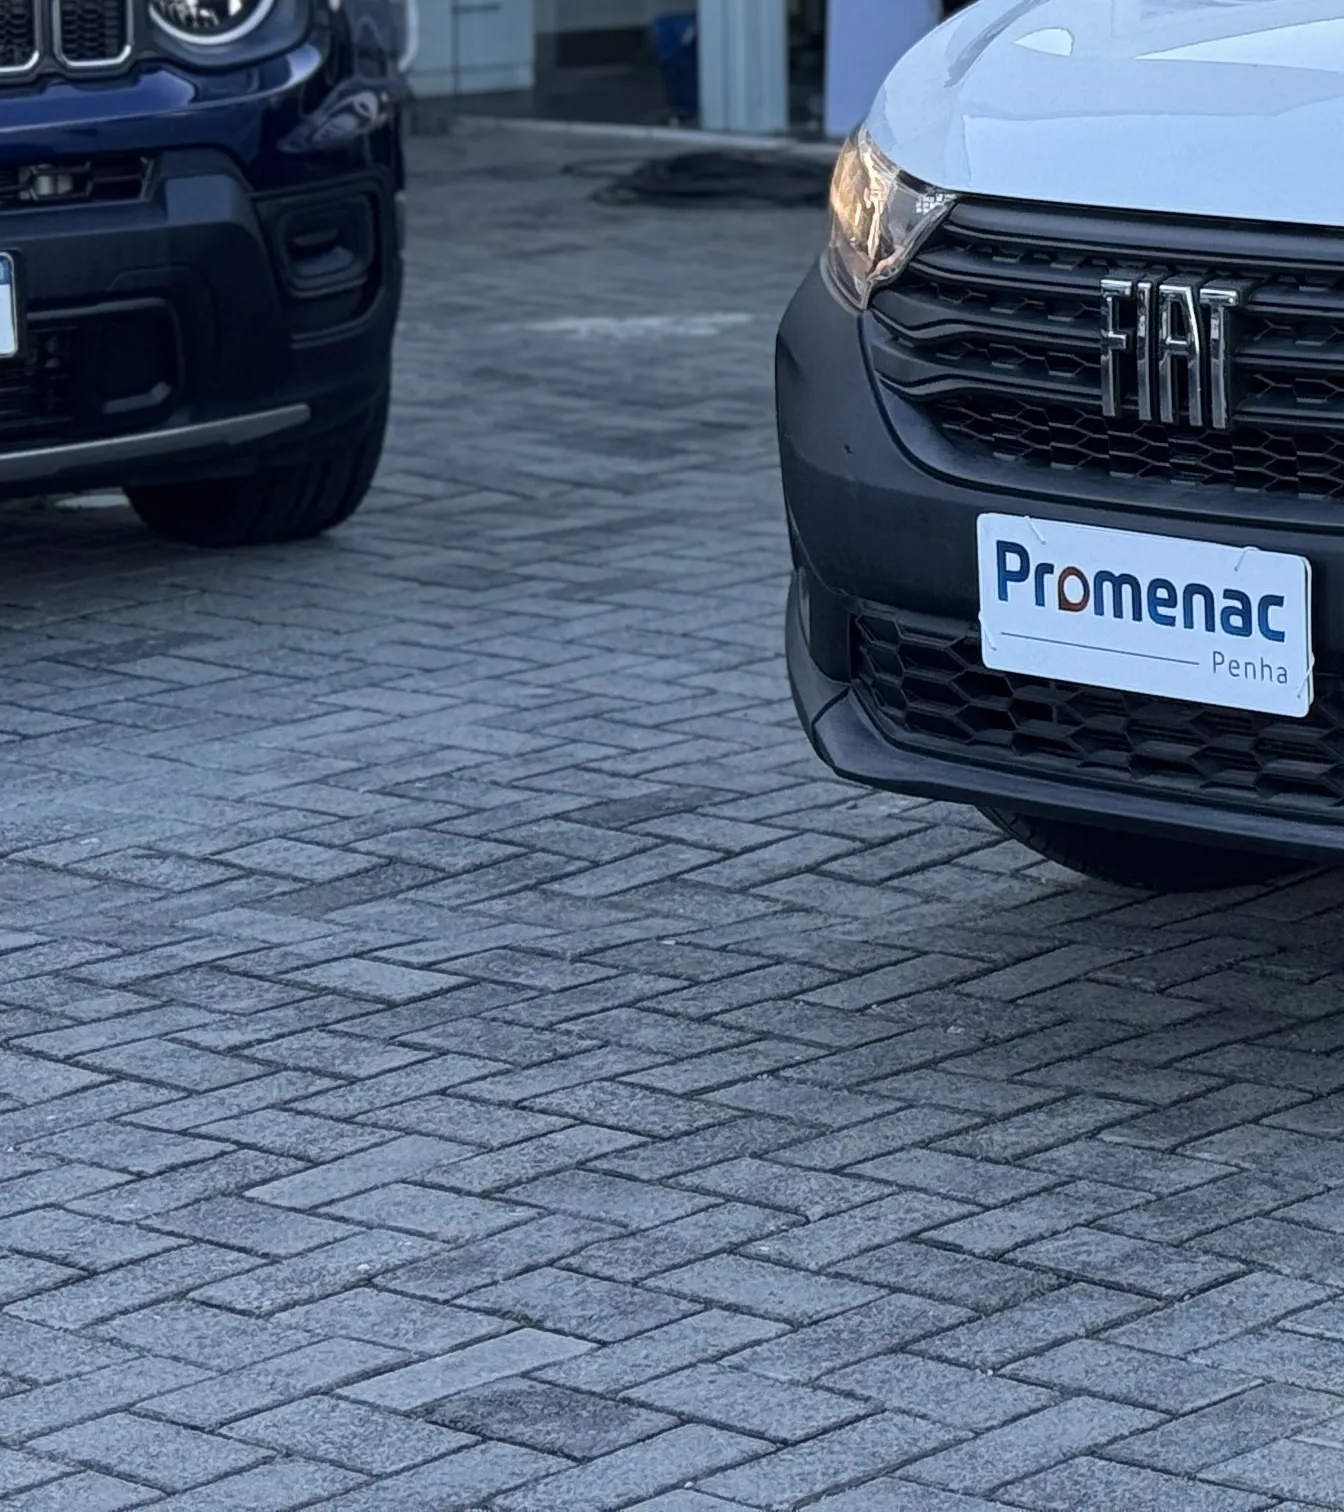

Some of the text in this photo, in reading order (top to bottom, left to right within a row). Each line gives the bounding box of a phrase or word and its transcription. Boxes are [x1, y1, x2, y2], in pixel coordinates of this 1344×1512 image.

[1100, 275, 1242, 430] FIAT
[996, 539, 1286, 644] Promenac
[1212, 650, 1289, 685] Penha
